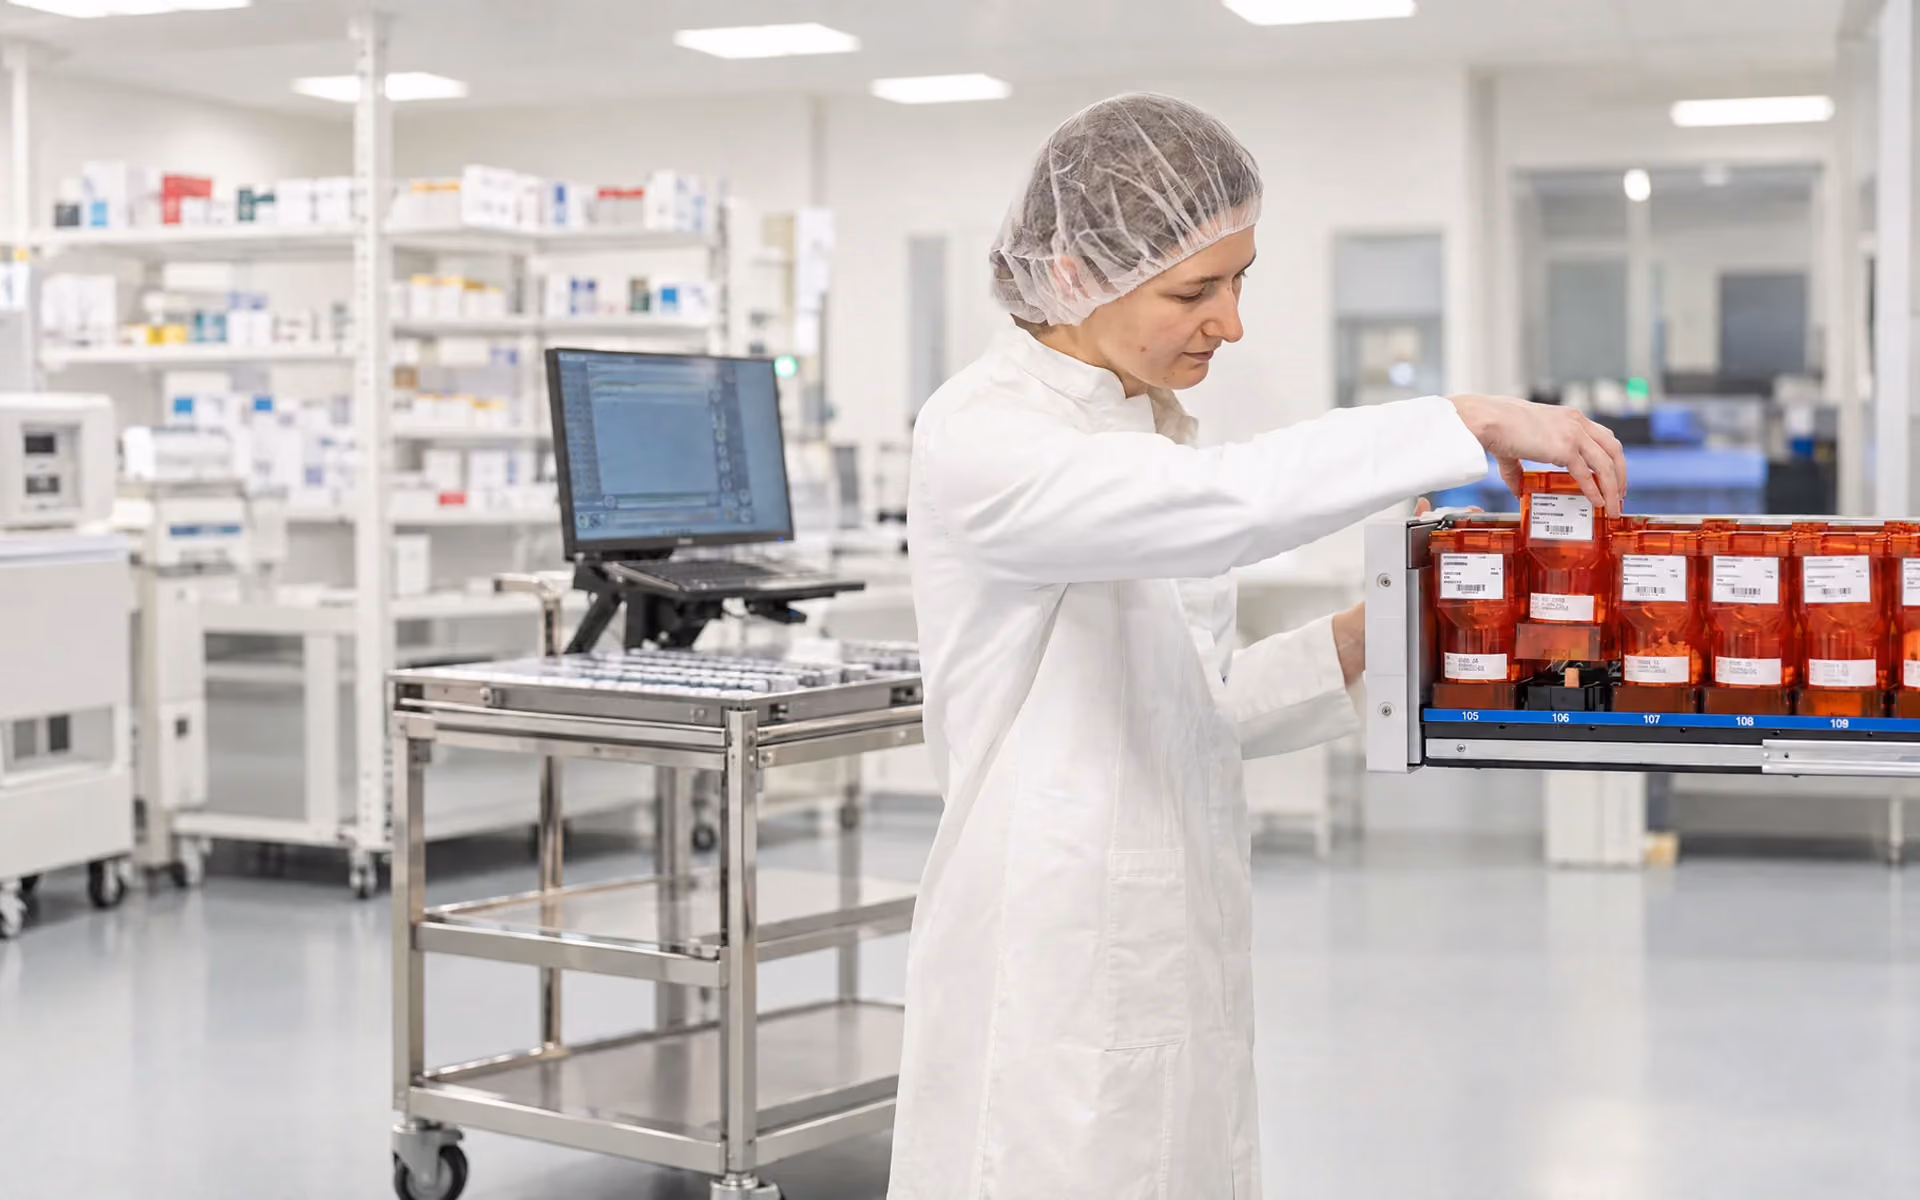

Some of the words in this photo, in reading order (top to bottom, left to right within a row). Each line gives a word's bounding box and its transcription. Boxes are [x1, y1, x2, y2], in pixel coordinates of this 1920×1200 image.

[1462, 711, 1479, 721] 105
[1552, 713, 1570, 723] 106
[1643, 714, 1661, 724] 107
[1735, 716, 1754, 727] 108
[1830, 718, 1849, 729] 109
